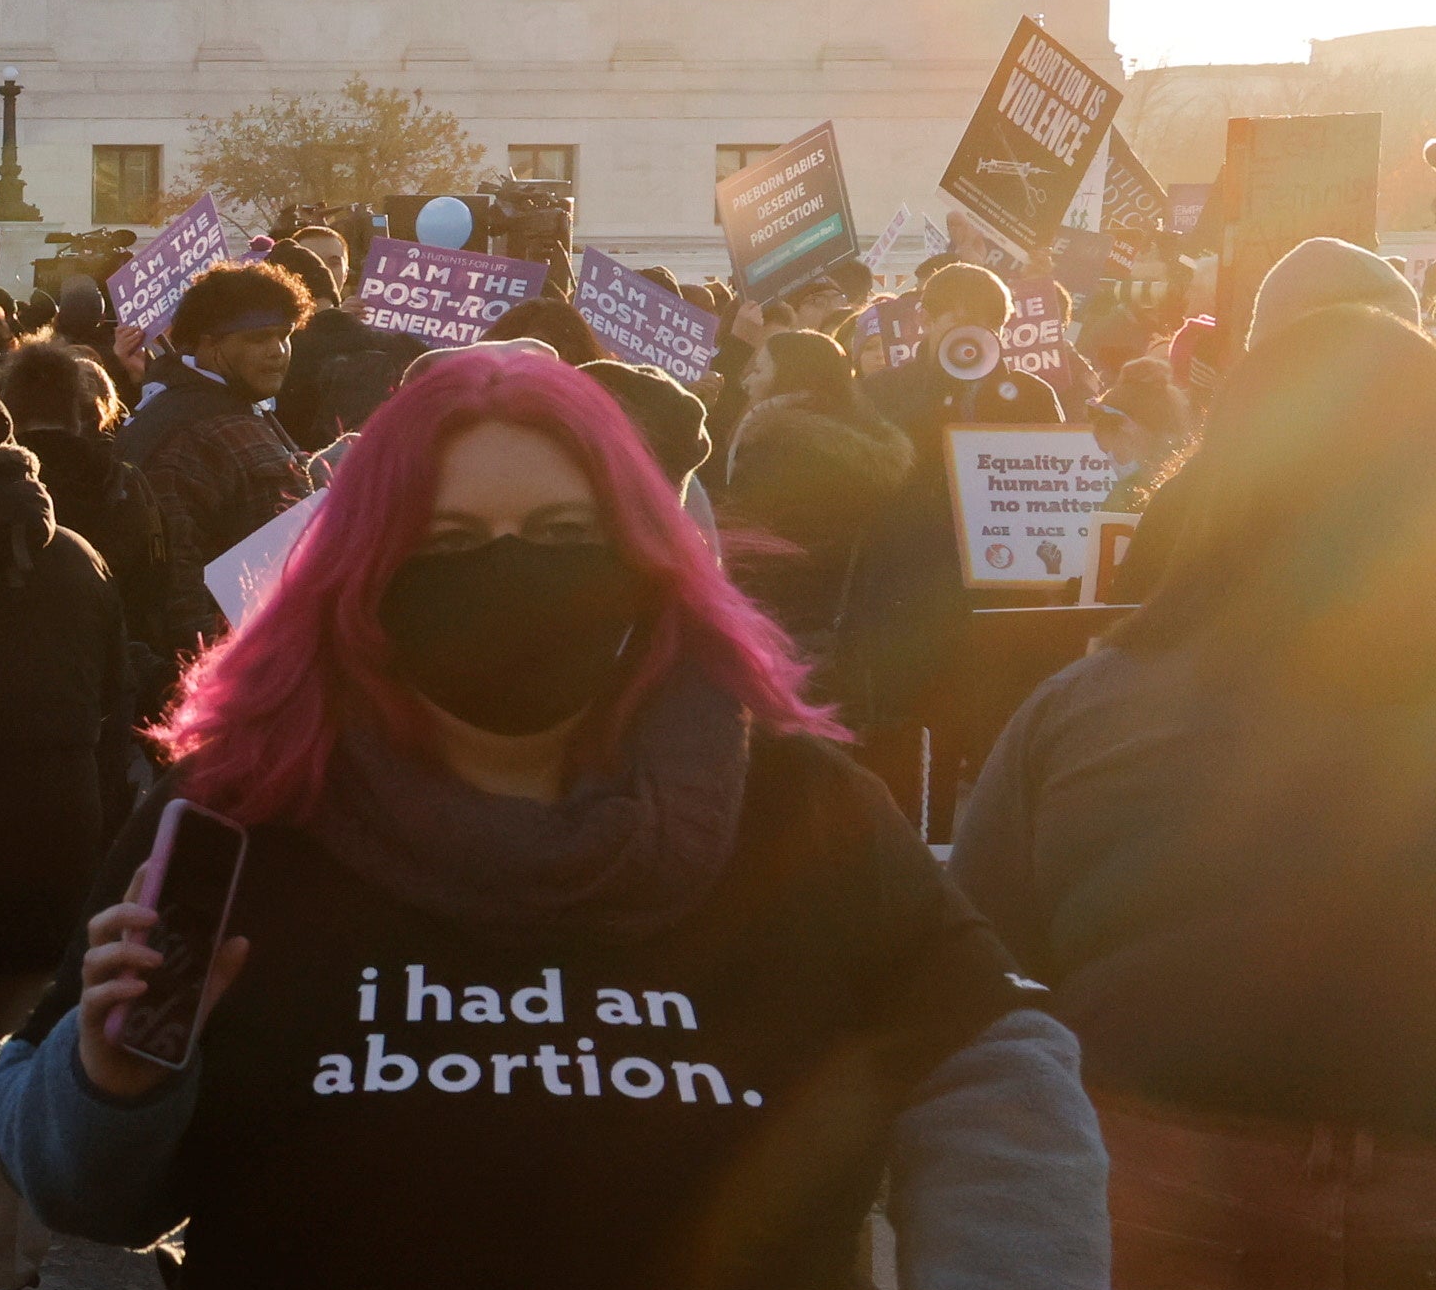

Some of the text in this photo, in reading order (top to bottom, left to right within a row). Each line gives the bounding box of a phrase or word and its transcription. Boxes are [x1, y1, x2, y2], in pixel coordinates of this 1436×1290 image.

[1017, 34, 1108, 121] ABORTION IS
[997, 67, 1091, 167] VIOLENCE
[732, 149, 826, 211] PREBORN BABIES
[757, 182, 806, 220] DESERVE
[134, 252, 164, 289] AM
[170, 212, 210, 253] THE
[750, 193, 825, 248] PROTECTION!
[1114, 241, 1135, 255] LIFE
[118, 223, 222, 324] POST-ROE
[376, 256, 528, 298] I AM THE
[421, 252, 489, 270] STUDENTS FOR
[580, 281, 711, 367] POST-ROE
[608, 278, 704, 340] AM THE
[580, 306, 702, 382] GENERATION
[977, 454, 1074, 475] Equality
[987, 476, 1069, 492] human
[982, 526, 1065, 536] AGE RACE
[990, 500, 1019, 512] no
[357, 964, 698, 1031] i had an
[313, 1033, 764, 1108] abortion.
